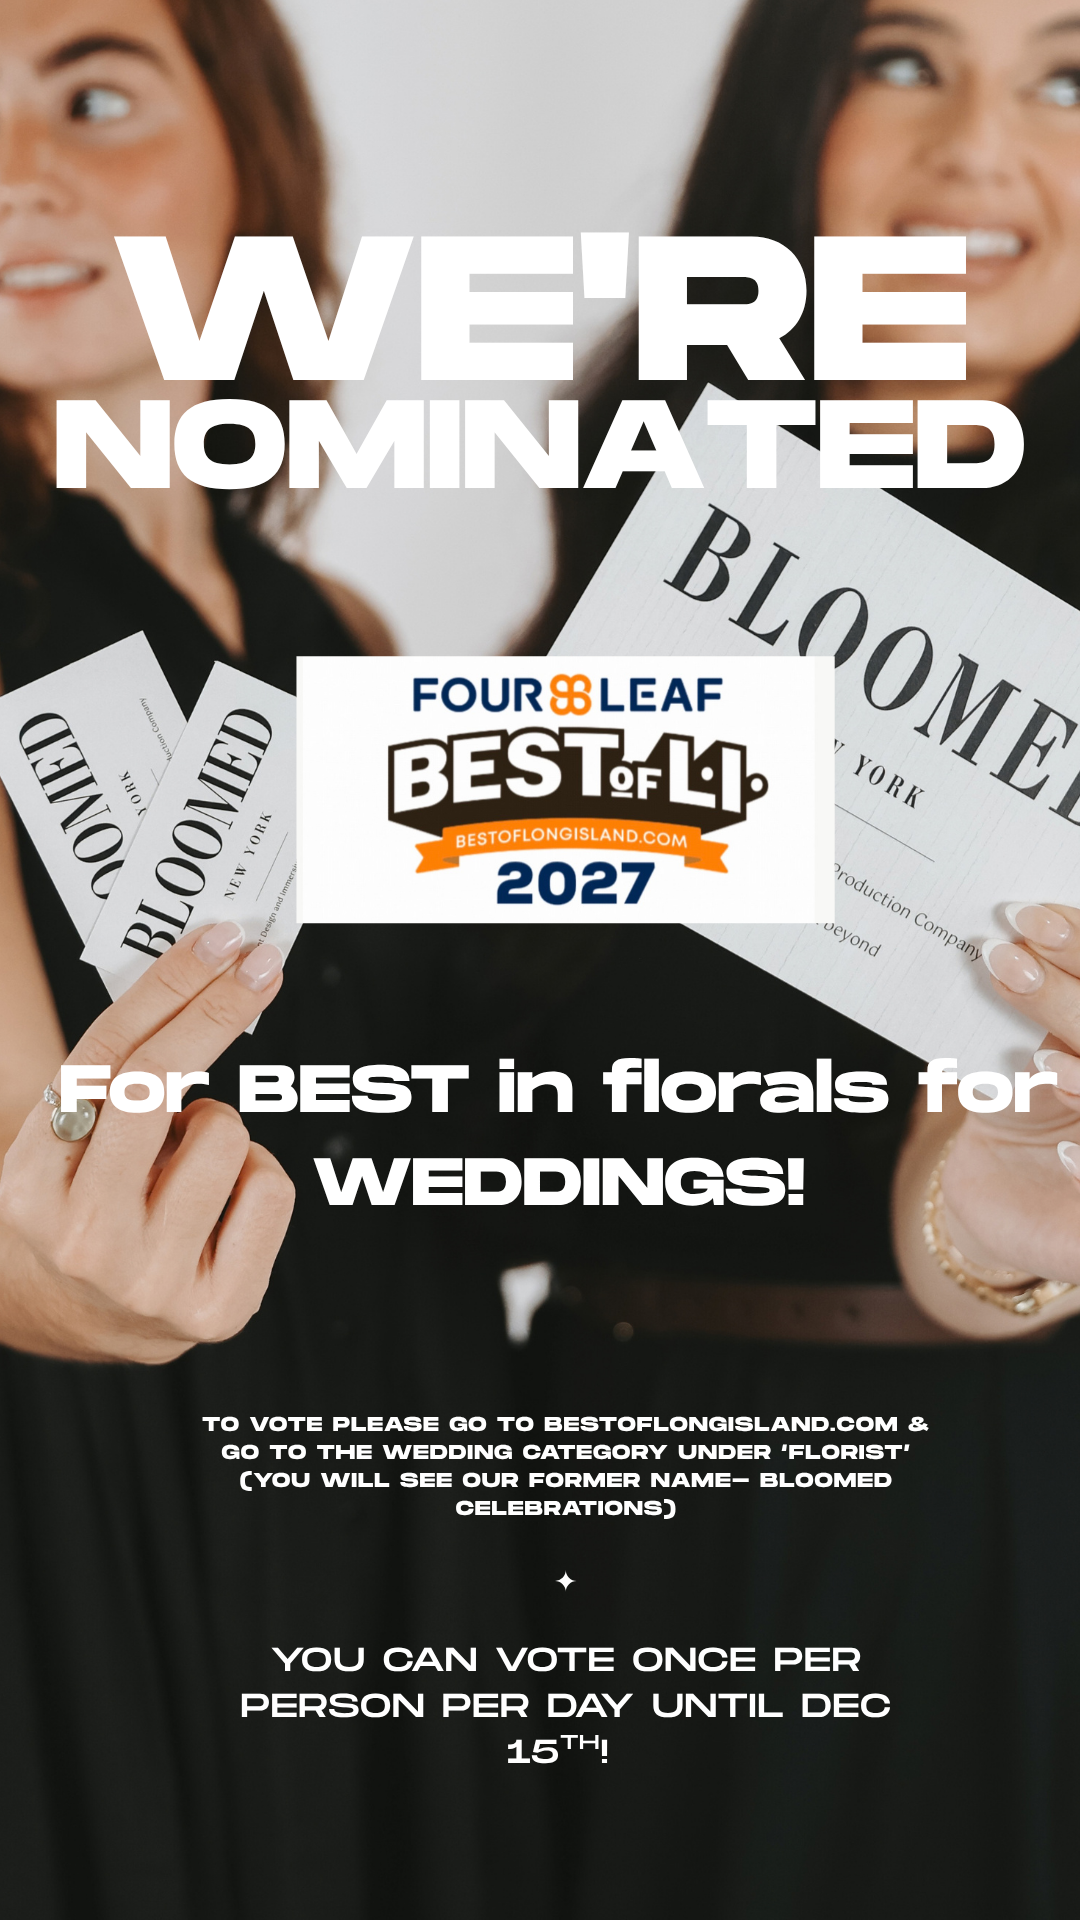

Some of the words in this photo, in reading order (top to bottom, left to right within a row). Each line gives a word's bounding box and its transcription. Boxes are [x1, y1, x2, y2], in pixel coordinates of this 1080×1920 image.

[139, 697, 160, 734] Company
[118, 770, 147, 816] YORK
[853, 753, 925, 809] YORK
[120, 708, 273, 959] BLOOMED
[224, 863, 247, 901] NEW
[243, 811, 272, 856] YORK
[260, 912, 277, 938] Design
[273, 896, 284, 912] and
[914, 912, 983, 962] Company
